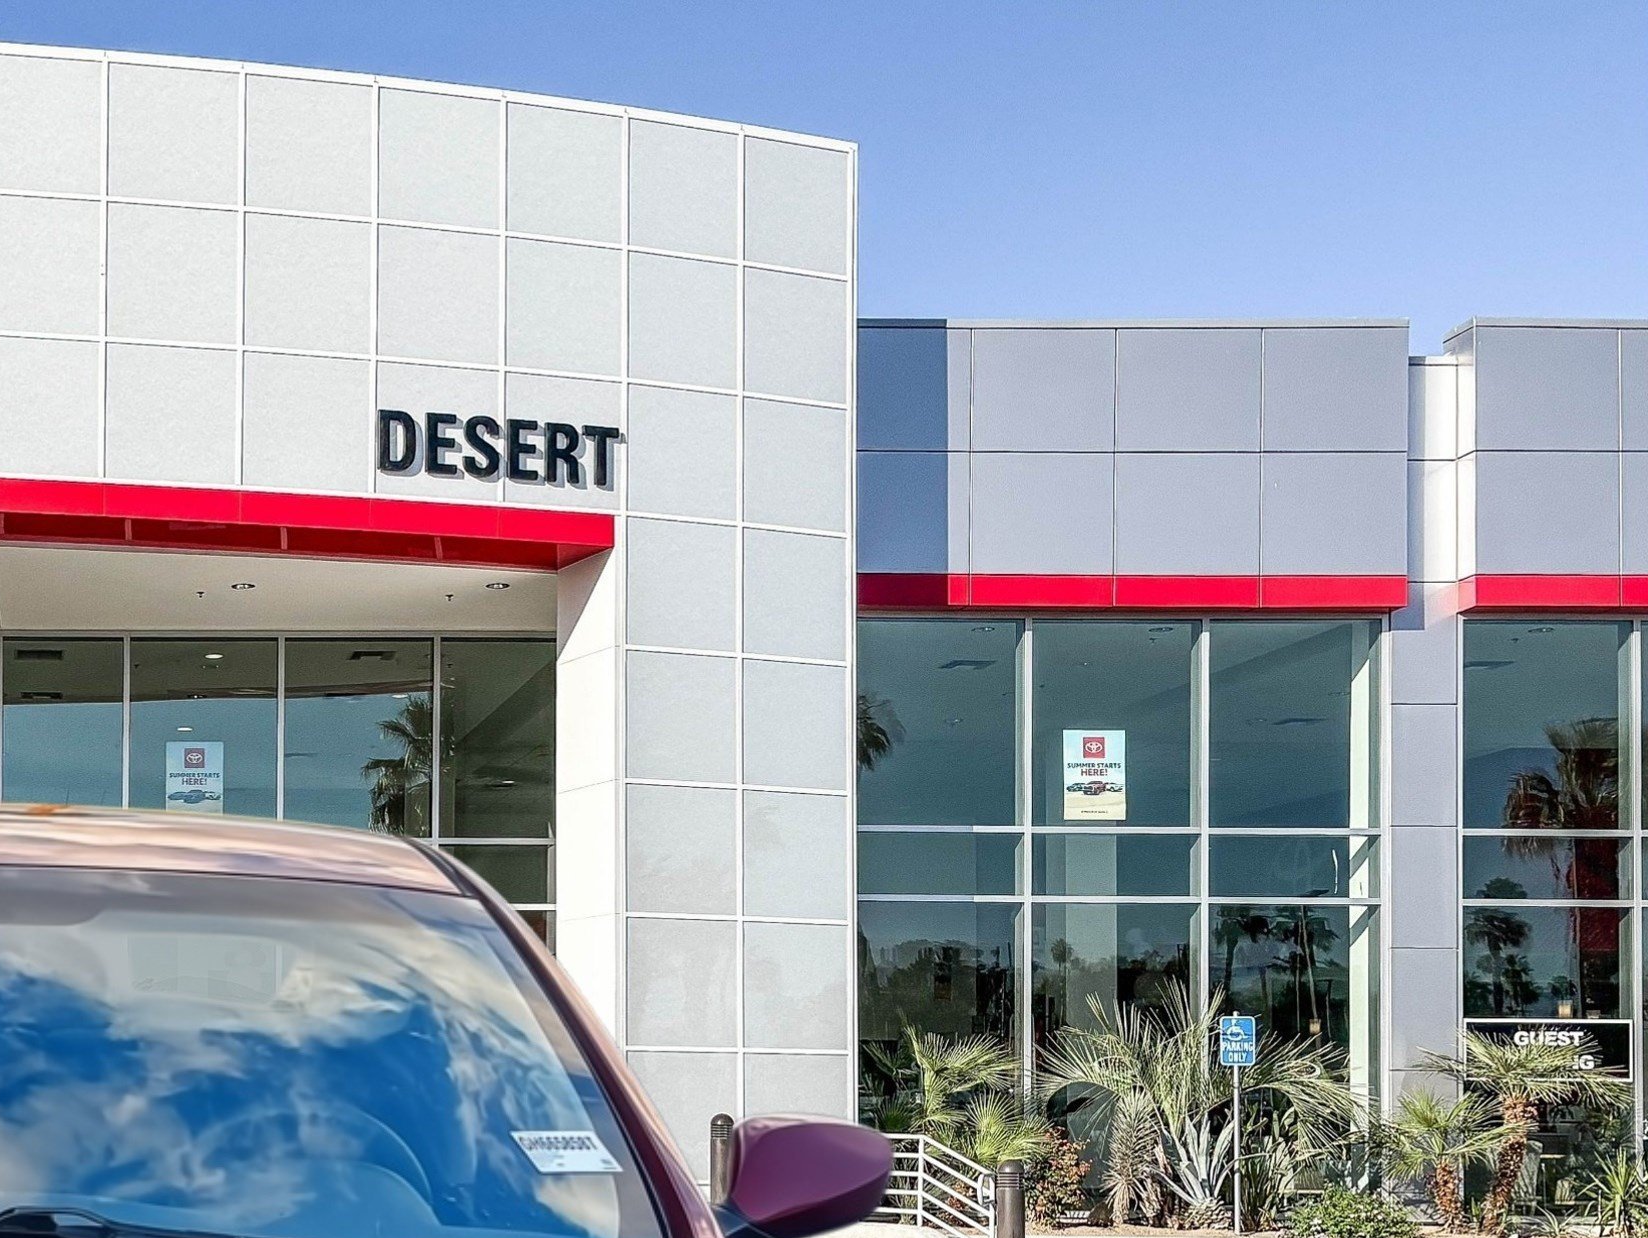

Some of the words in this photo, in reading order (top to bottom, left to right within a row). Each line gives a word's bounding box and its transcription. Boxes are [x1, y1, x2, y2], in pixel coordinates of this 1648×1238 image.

[377, 409, 622, 487] DESERT
[1080, 768, 1108, 776] HERE!
[181, 778, 207, 786] HERE!
[1513, 1030, 1584, 1046] GUEST
[1222, 1042, 1254, 1051] PARKING
[1228, 1052, 1247, 1062] ONLY
